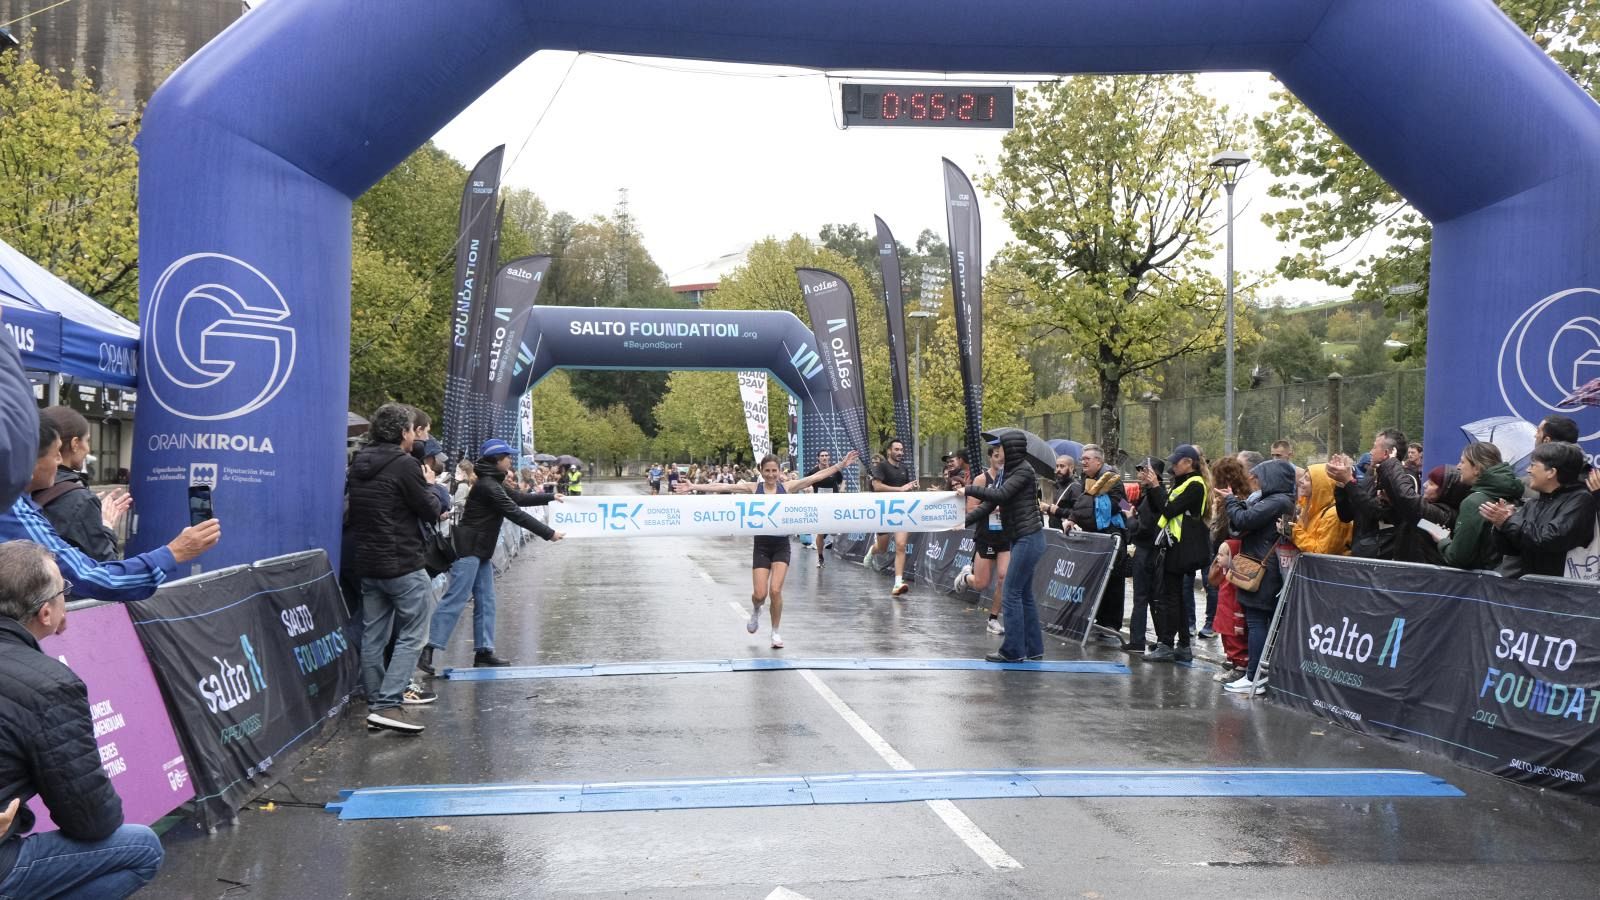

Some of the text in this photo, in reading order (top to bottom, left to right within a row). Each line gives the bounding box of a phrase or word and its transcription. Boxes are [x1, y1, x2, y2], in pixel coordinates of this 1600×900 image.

[882, 93, 994, 120] 0:55:21
[506, 267, 533, 280] salto
[569, 321, 758, 340] SALTO FOUNDATION .org
[489, 326, 507, 382] salto
[623, 340, 683, 351] #BeyondSport
[148, 433, 275, 454] ORAINKIROLA
[555, 512, 598, 524] SALTO
[693, 510, 736, 522] SALTO
[833, 508, 876, 520] SALTO
[1054, 558, 1075, 578] SALTO
[281, 604, 315, 638] SALTO
[1308, 616, 1374, 663] salto
[1495, 628, 1577, 672] SALTO
[199, 656, 251, 714] salto
[1471, 709, 1499, 729] .org
